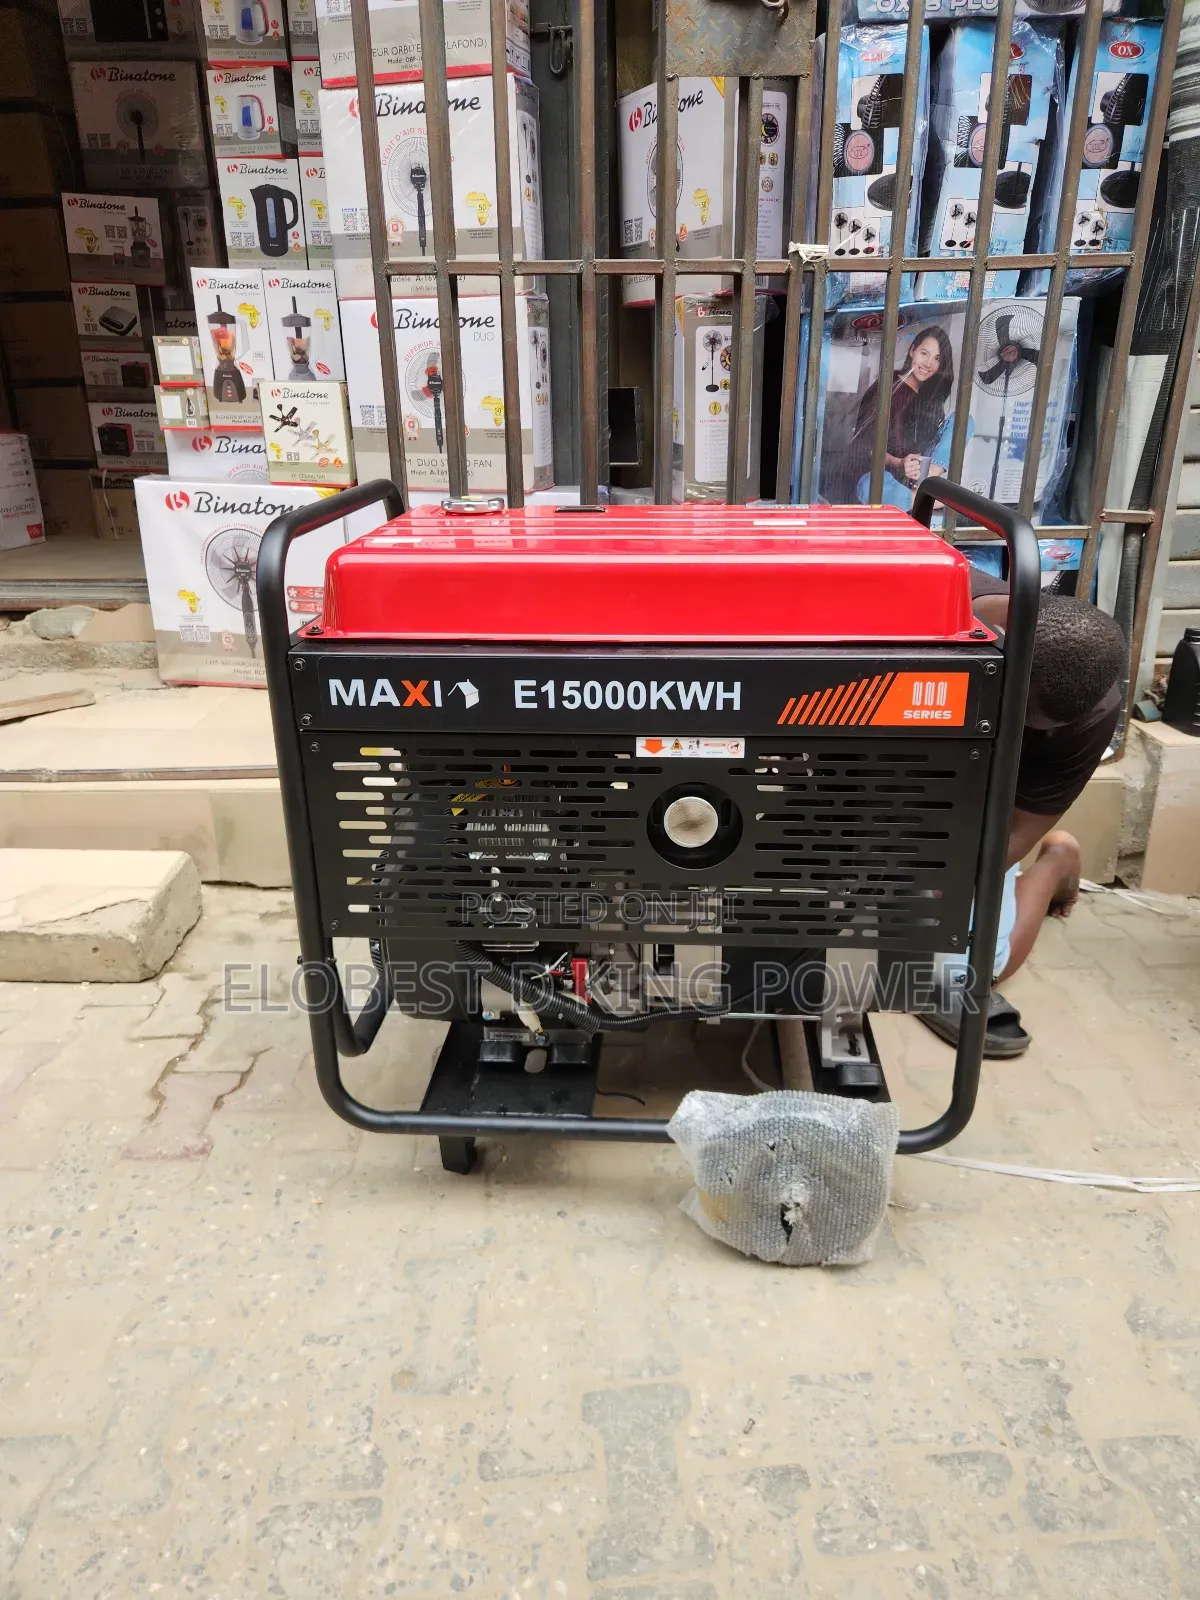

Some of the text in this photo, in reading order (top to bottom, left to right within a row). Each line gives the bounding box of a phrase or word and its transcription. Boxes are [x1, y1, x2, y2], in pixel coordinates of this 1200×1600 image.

[950, 0, 998, 12] PLU
[444, 37, 488, 50] LAFOND)
[107, 66, 177, 82] Binatone
[223, 72, 267, 84] Binatone
[374, 92, 482, 117] Binane
[643, 90, 704, 128] Bione
[239, 163, 288, 175] Binatone
[78, 198, 126, 211] Binatone
[208, 278, 260, 290] Binatone
[280, 277, 332, 289] Binatone
[88, 286, 131, 297] Binatone
[708, 306, 732, 316] Bina
[166, 316, 197, 329] aton
[394, 308, 496, 329] Binaone
[473, 332, 494, 342] DUO
[404, 340, 434, 362] SUPERIOR
[282, 387, 329, 399] Binatone
[114, 407, 158, 418] Binaton
[214, 435, 266, 454] Bina
[417, 458, 438, 467] DUO
[473, 459, 492, 468] FAN
[193, 490, 303, 516] Binaton
[328, 678, 741, 711] MAXI E15000KWH
[903, 709, 953, 720] SERIES
